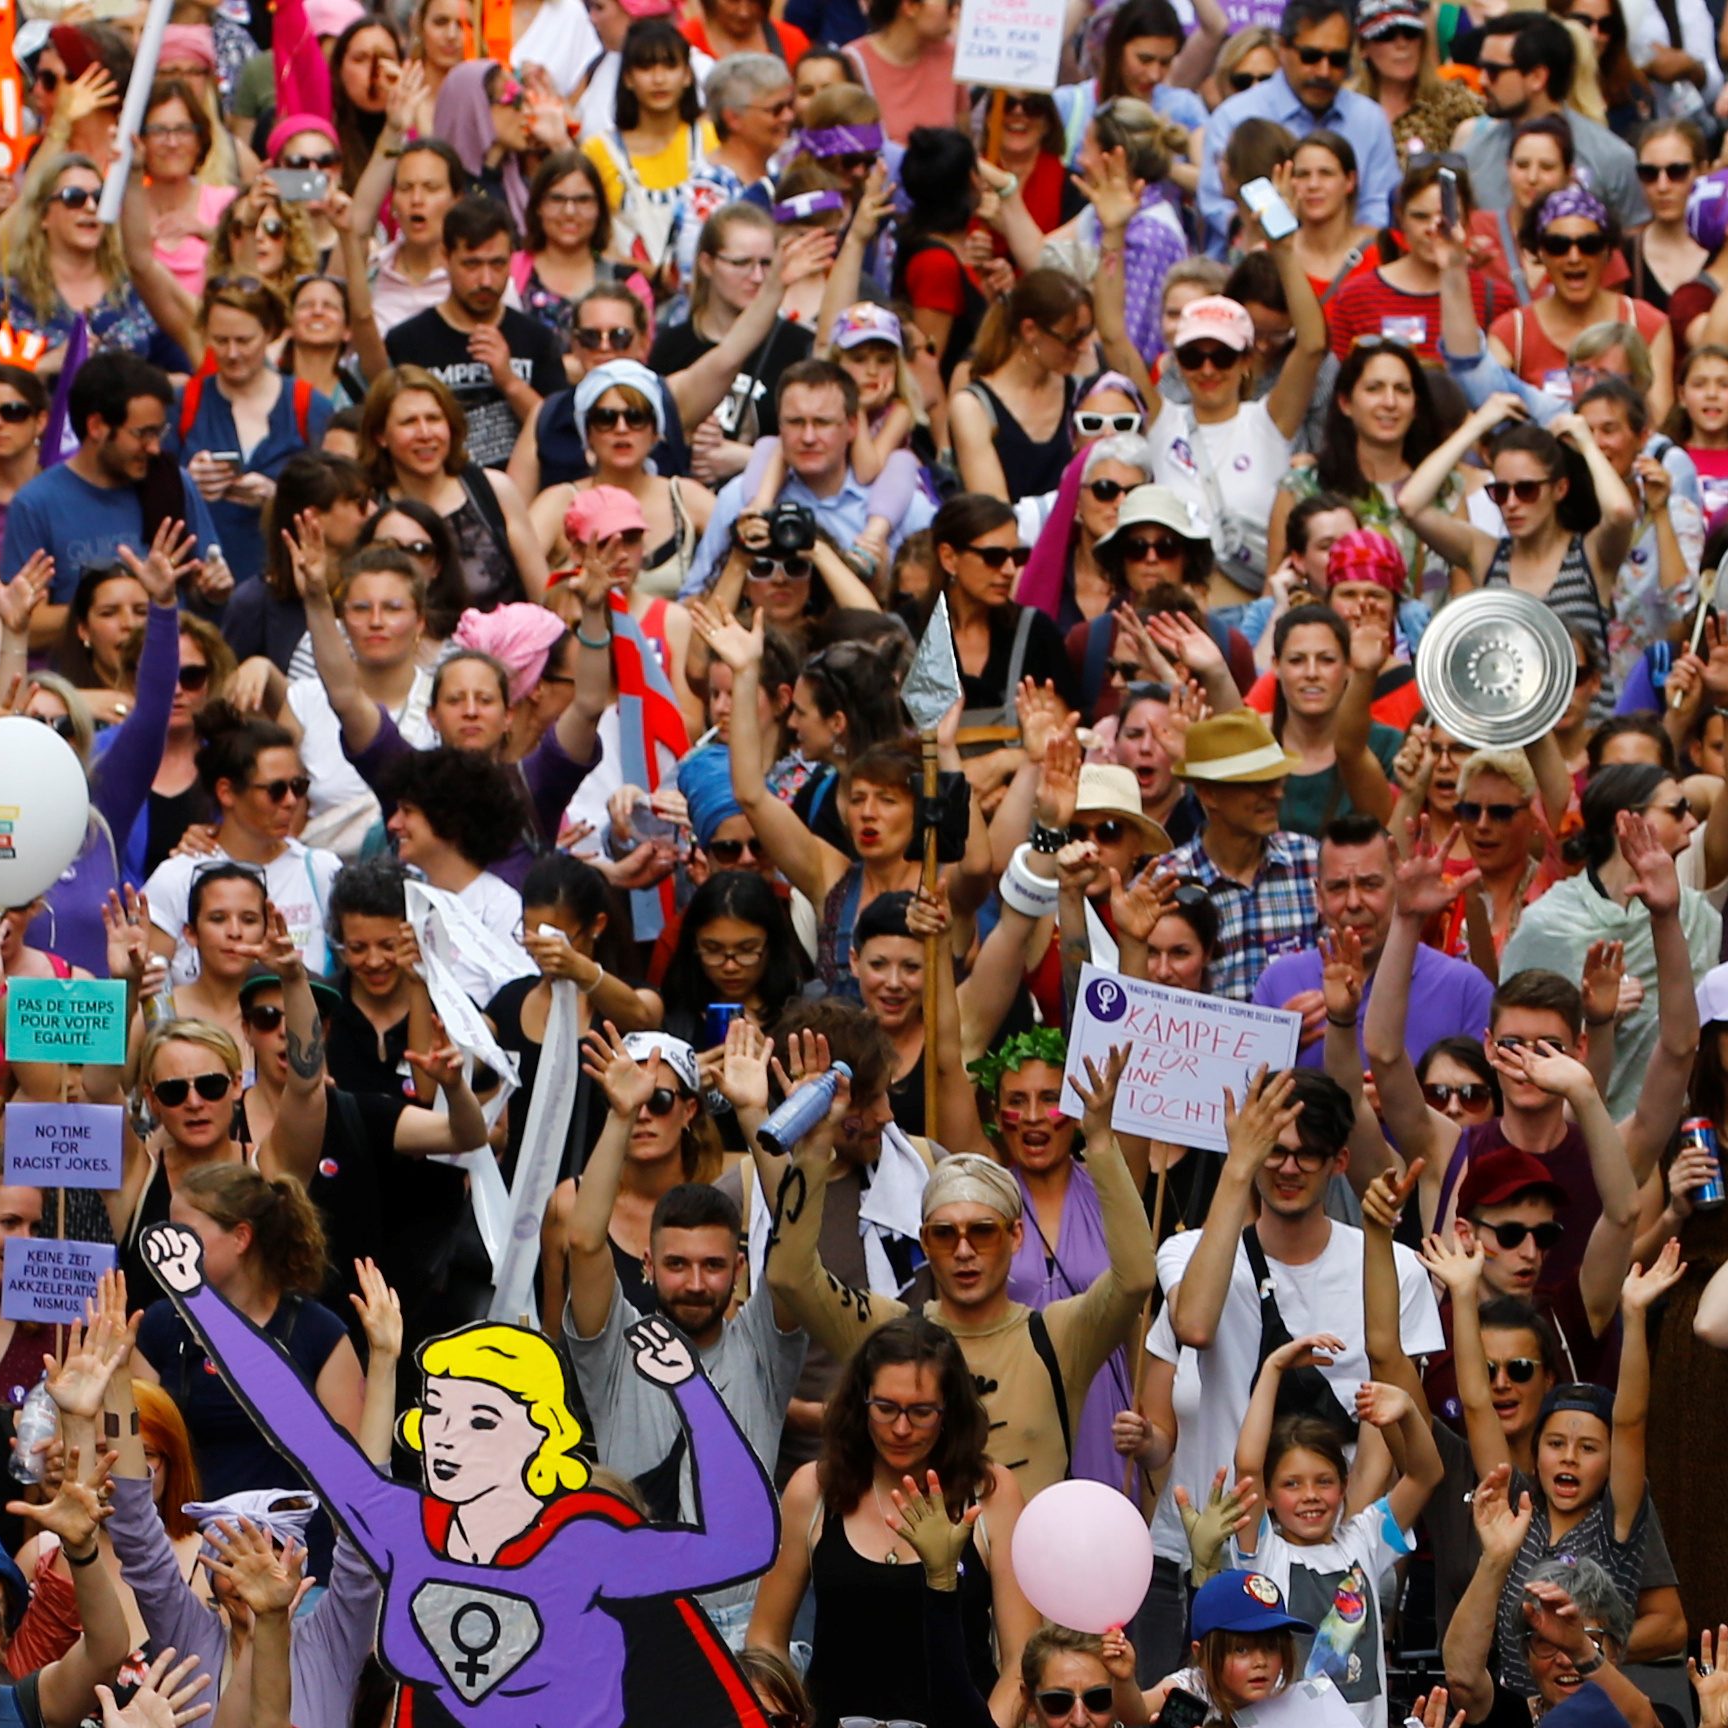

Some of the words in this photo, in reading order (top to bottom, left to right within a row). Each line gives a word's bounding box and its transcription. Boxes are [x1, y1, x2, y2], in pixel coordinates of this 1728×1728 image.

[16, 998, 42, 1014] PAS
[46, 999, 66, 1014] DE
[68, 999, 115, 1016] TEMPS
[20, 1014, 60, 1030] POUR
[63, 1015, 111, 1032] VOTRE
[1123, 1002, 1261, 1059] KÄMPFE
[1138, 1045, 1200, 1079] FÜR
[1123, 1083, 1222, 1126] TOCHT
[34, 1124, 57, 1140] NO
[60, 1125, 92, 1141] TIME
[50, 1140, 80, 1156] FOR
[12, 1155, 62, 1171] RACIST
[63, 1157, 112, 1173] JOKES.
[26, 1249, 64, 1265] KEINE
[66, 1251, 92, 1267] ZEIT
[22, 1262, 49, 1279] FÜR
[52, 1266, 97, 1283] DEINEN
[32, 1297, 83, 1313] NISMUS.
